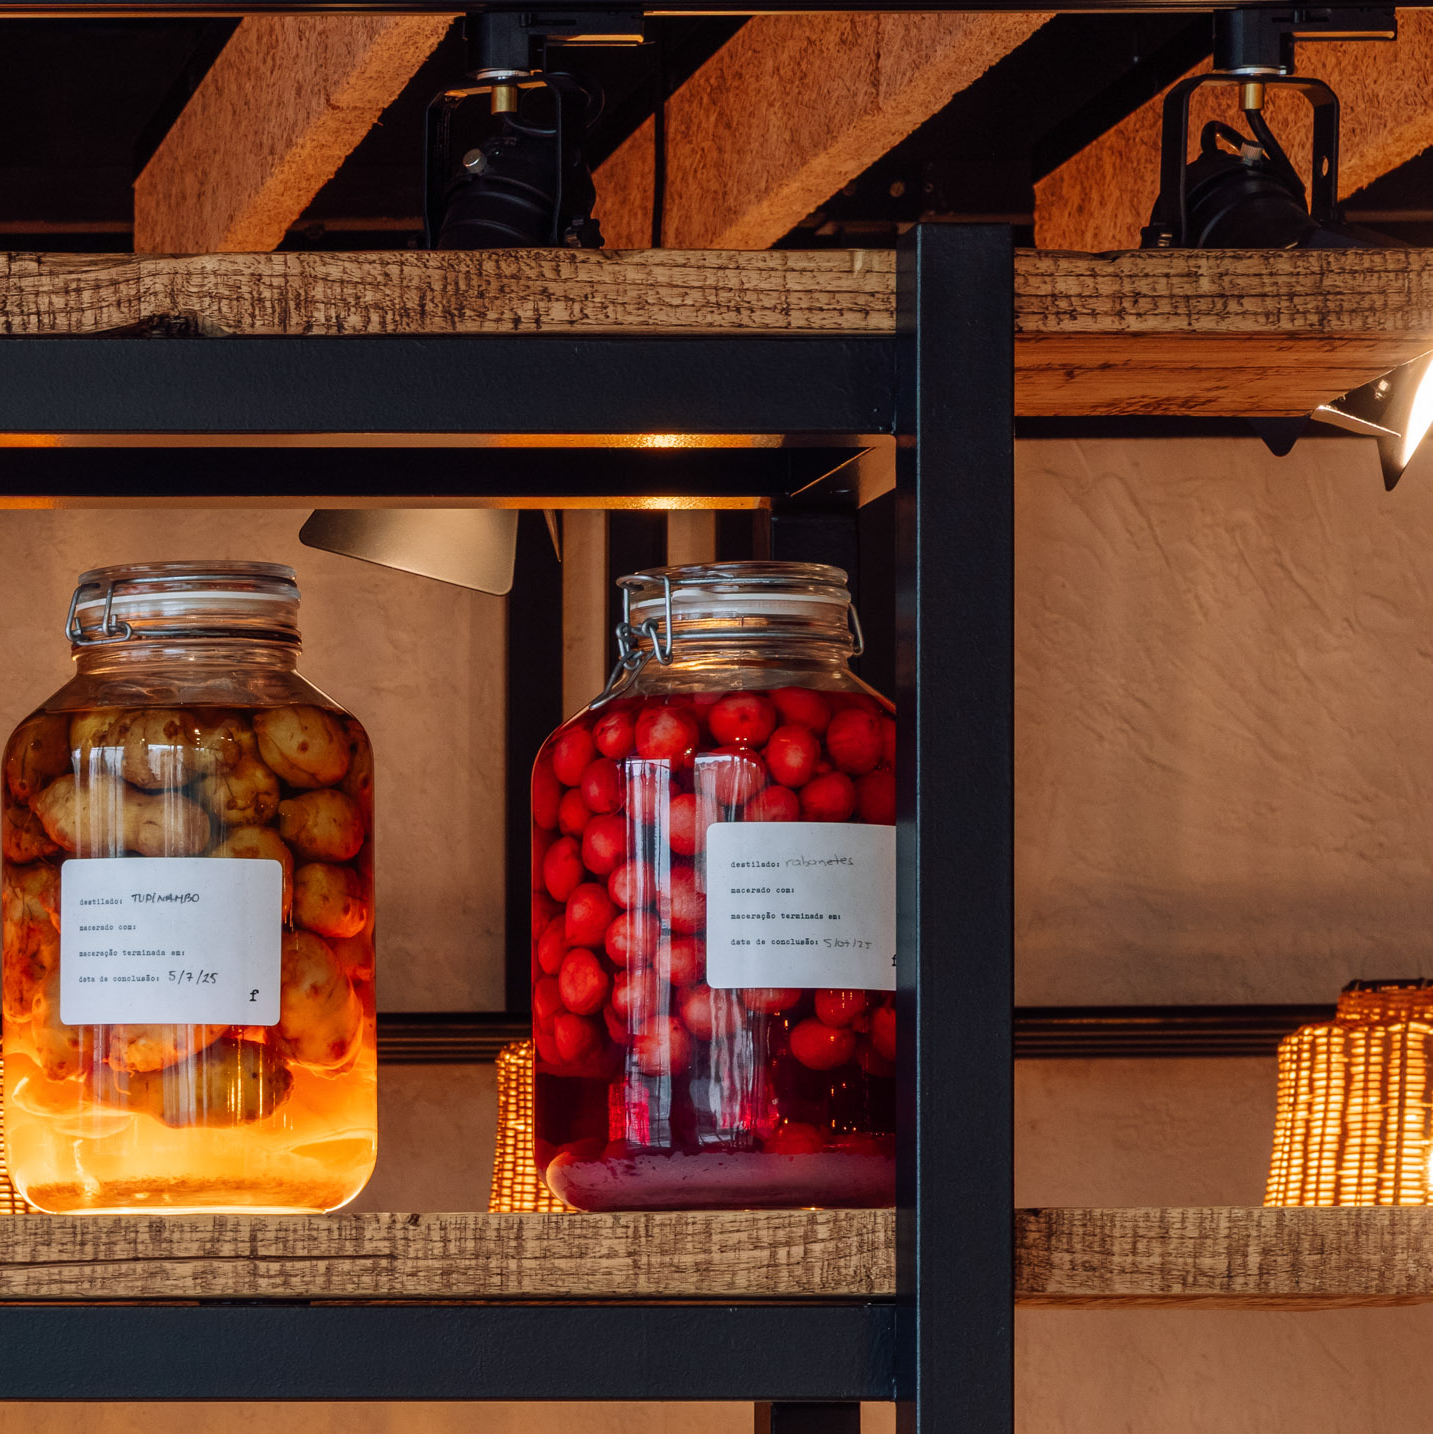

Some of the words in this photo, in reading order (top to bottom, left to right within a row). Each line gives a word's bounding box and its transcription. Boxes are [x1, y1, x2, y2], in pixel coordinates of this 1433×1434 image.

[730, 860, 781, 869] destilado:
[730, 886, 772, 894] macerado
[79, 897, 123, 906] destilado:
[730, 911, 777, 921] maceração
[780, 912, 824, 920] terminada
[827, 913, 841, 921] em:
[78, 923, 115, 932] macerado
[117, 924, 137, 932] com:
[730, 938, 751, 946] data
[755, 938, 766, 946] de
[770, 937, 819, 946] conclusão:
[78, 948, 119, 959] maceração
[122, 948, 166, 957] terminada
[78, 975, 96, 984] data
[99, 975, 109, 983] de
[112, 973, 160, 983] conclusão:
[248, 988, 260, 1003] f
